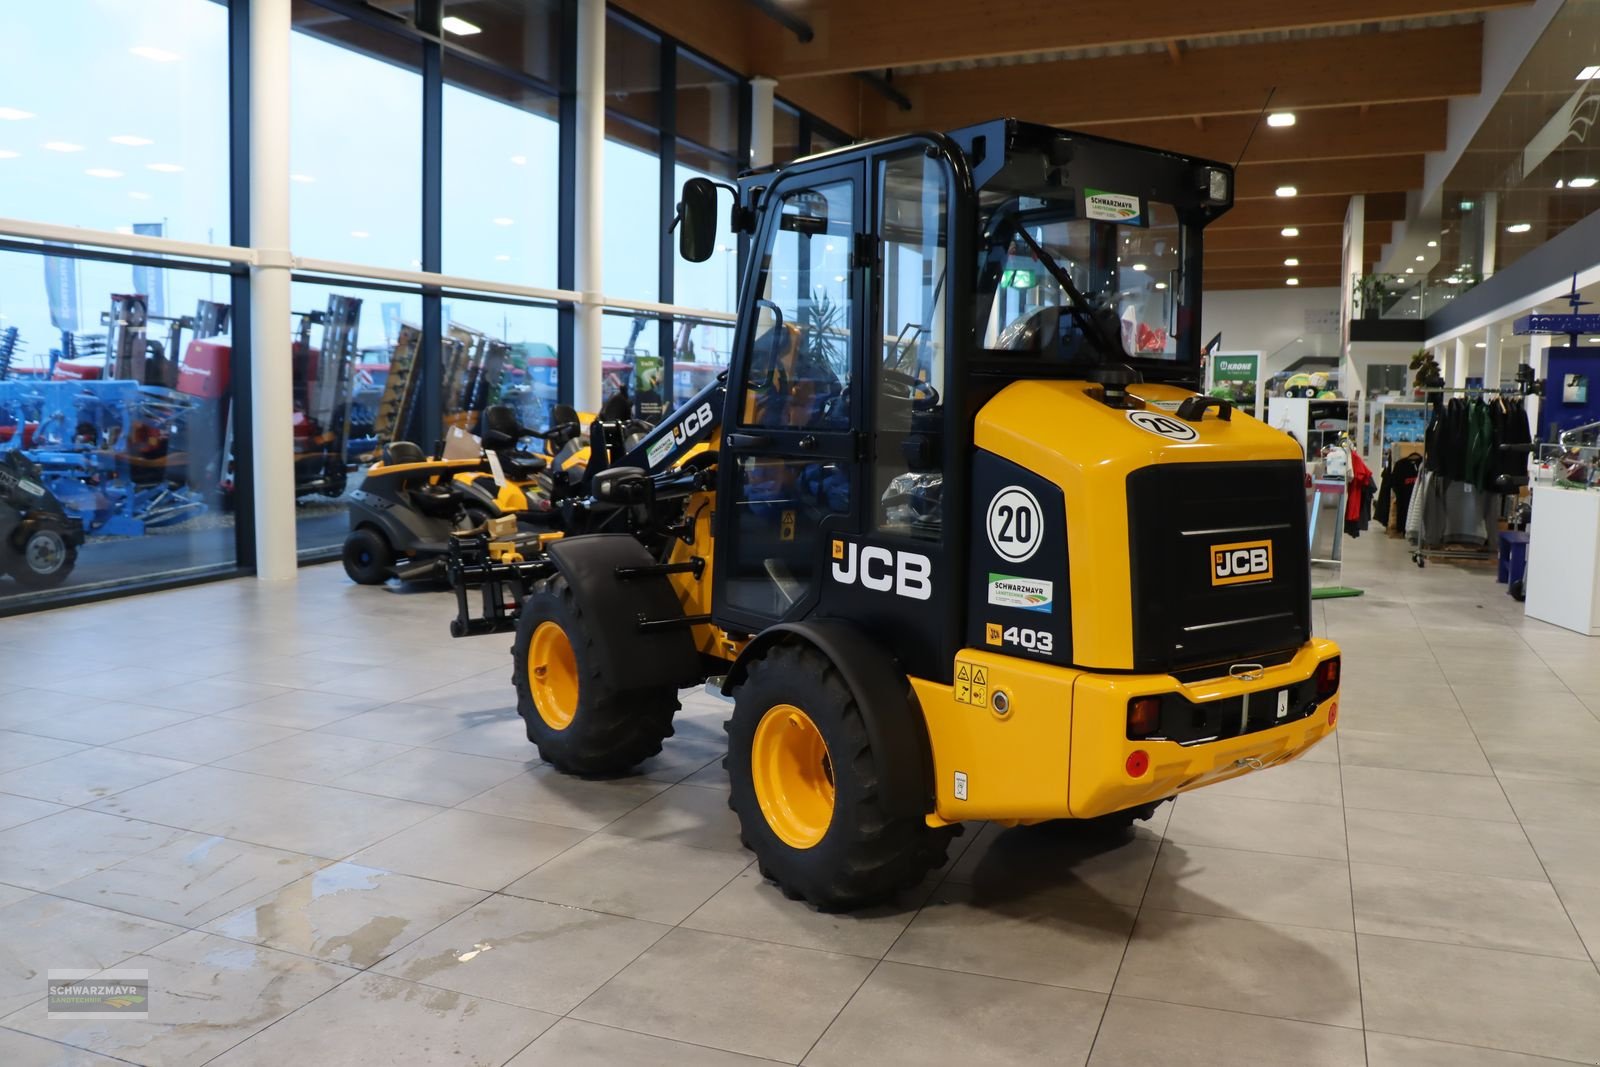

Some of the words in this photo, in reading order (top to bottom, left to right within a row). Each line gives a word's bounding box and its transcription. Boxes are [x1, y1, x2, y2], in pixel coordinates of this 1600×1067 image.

[1090, 196, 1132, 209] SCHWARZMAYR
[1227, 362, 1252, 370] KRONE
[675, 402, 713, 446] JCB
[1138, 417, 1186, 433] 20
[997, 505, 1032, 543] 20
[831, 542, 932, 601] JCB
[1216, 548, 1268, 577] JCB
[994, 582, 1044, 595] SCHWARZMAYR
[1003, 626, 1053, 651] 403
